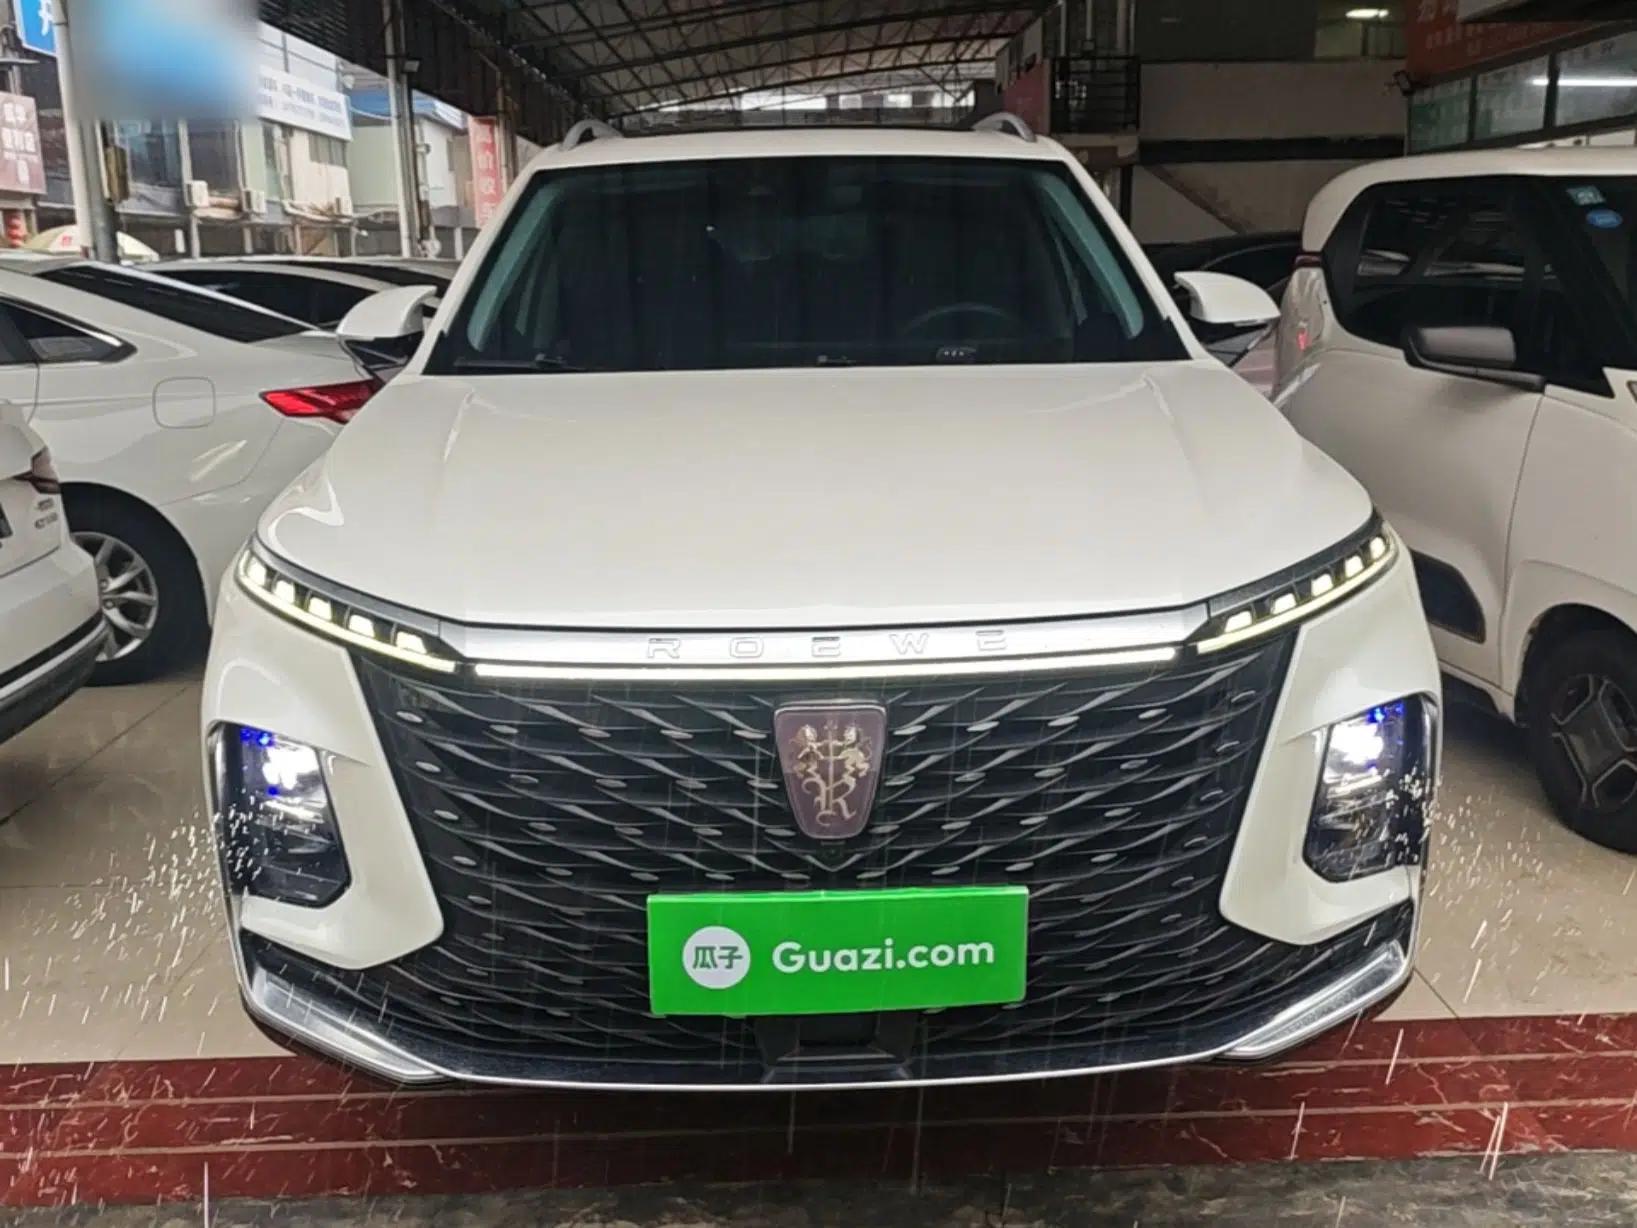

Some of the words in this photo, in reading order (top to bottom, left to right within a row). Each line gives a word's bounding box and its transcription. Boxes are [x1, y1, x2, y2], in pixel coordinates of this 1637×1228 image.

[646, 629, 1007, 660] ROEWE
[692, 945, 743, 970] 瓜子
[772, 938, 995, 973] Guazi.com
